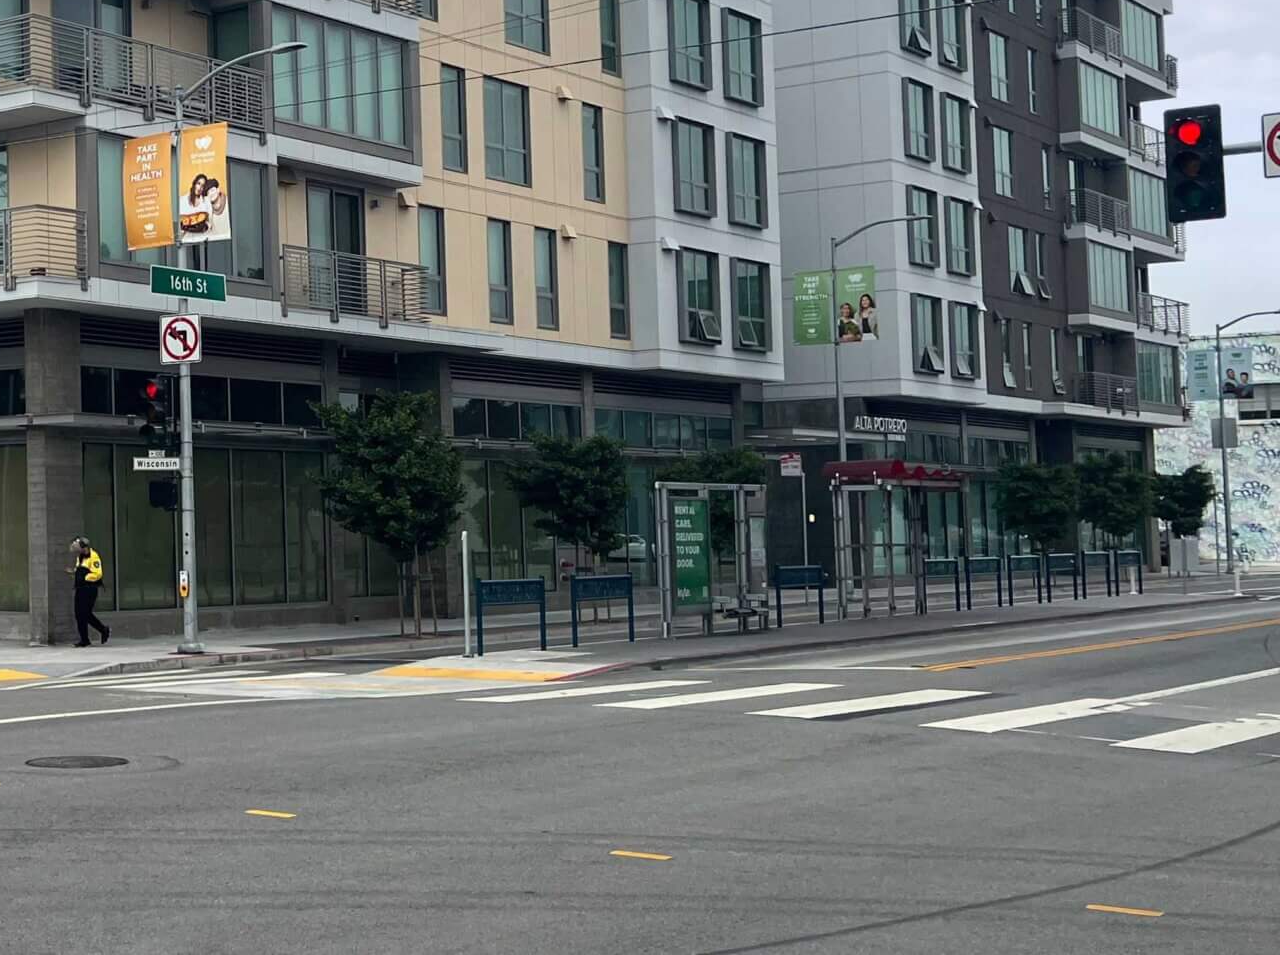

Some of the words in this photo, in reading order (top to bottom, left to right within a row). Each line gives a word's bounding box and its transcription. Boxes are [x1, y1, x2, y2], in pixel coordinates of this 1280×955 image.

[137, 143, 158, 153] TAKE
[136, 152, 158, 164] PART
[142, 163, 151, 171] IN
[130, 169, 162, 182] HEALTH
[170, 275, 193, 292] 16th
[196, 278, 208, 294] St
[854, 415, 873, 431] ALTA
[874, 417, 907, 433] POTRERO
[137, 459, 177, 468] Wisconsin
[674, 506, 695, 515] RENTAL
[675, 532, 704, 541] DELIVERED
[676, 546, 684, 555] TO
[685, 546, 700, 555] YOUR
